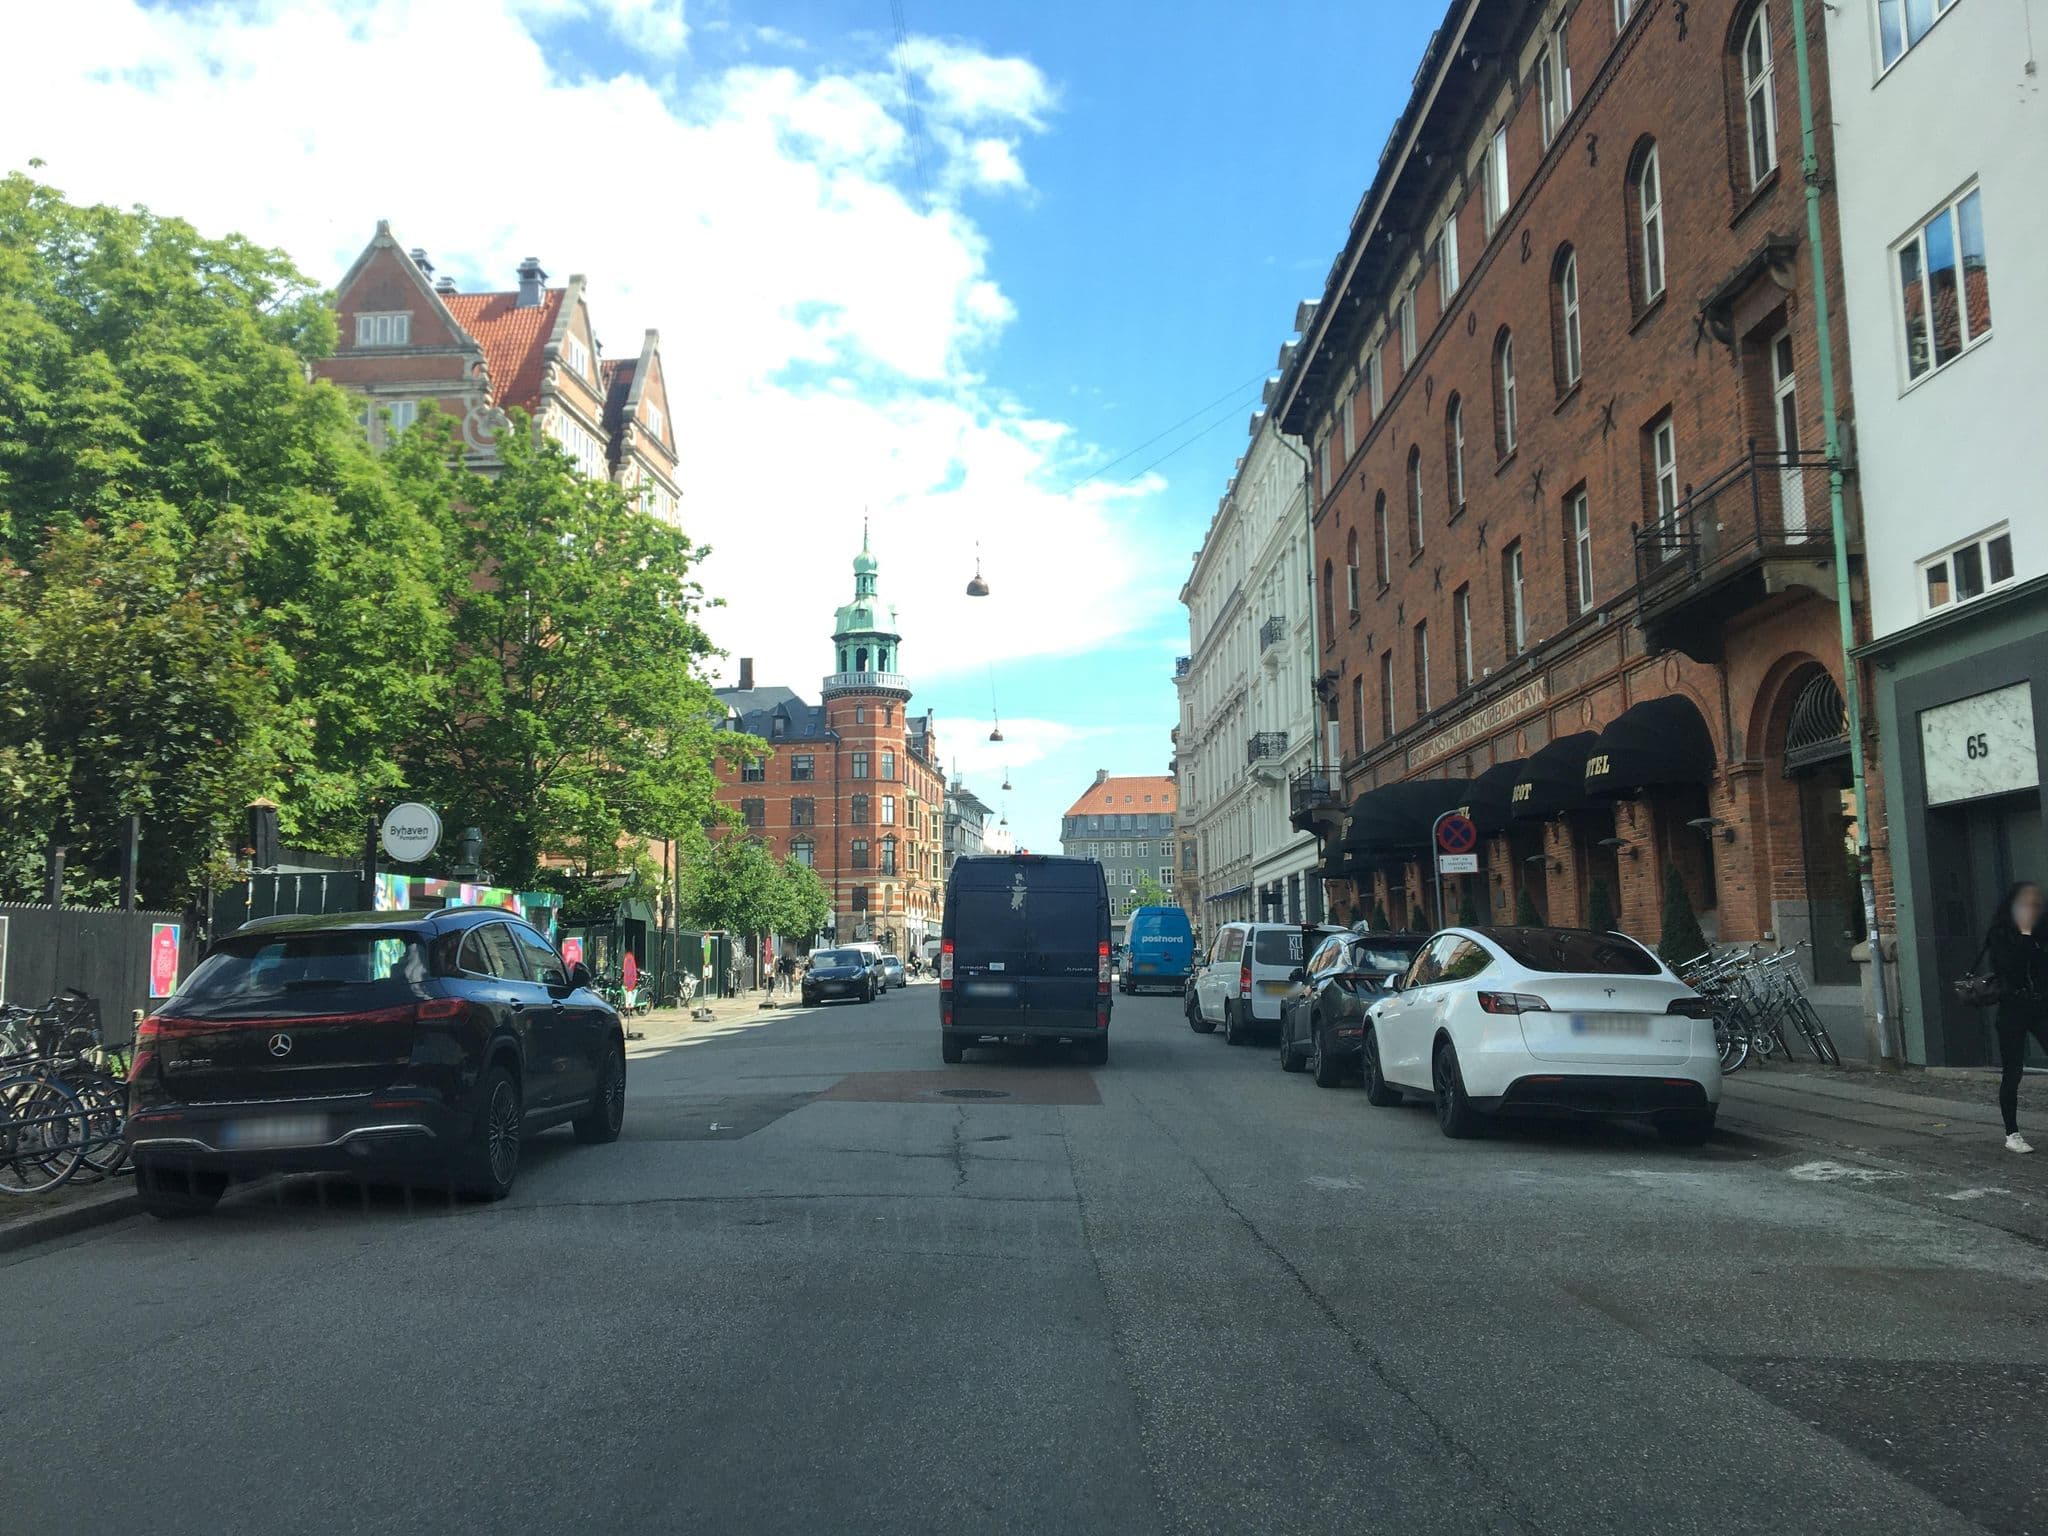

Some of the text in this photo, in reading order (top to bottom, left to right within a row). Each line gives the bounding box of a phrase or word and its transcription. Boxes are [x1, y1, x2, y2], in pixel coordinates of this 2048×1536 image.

[1967, 733, 1988, 760] 65
[390, 825, 429, 836] Byhaven
[1142, 935, 1184, 944] postnord
